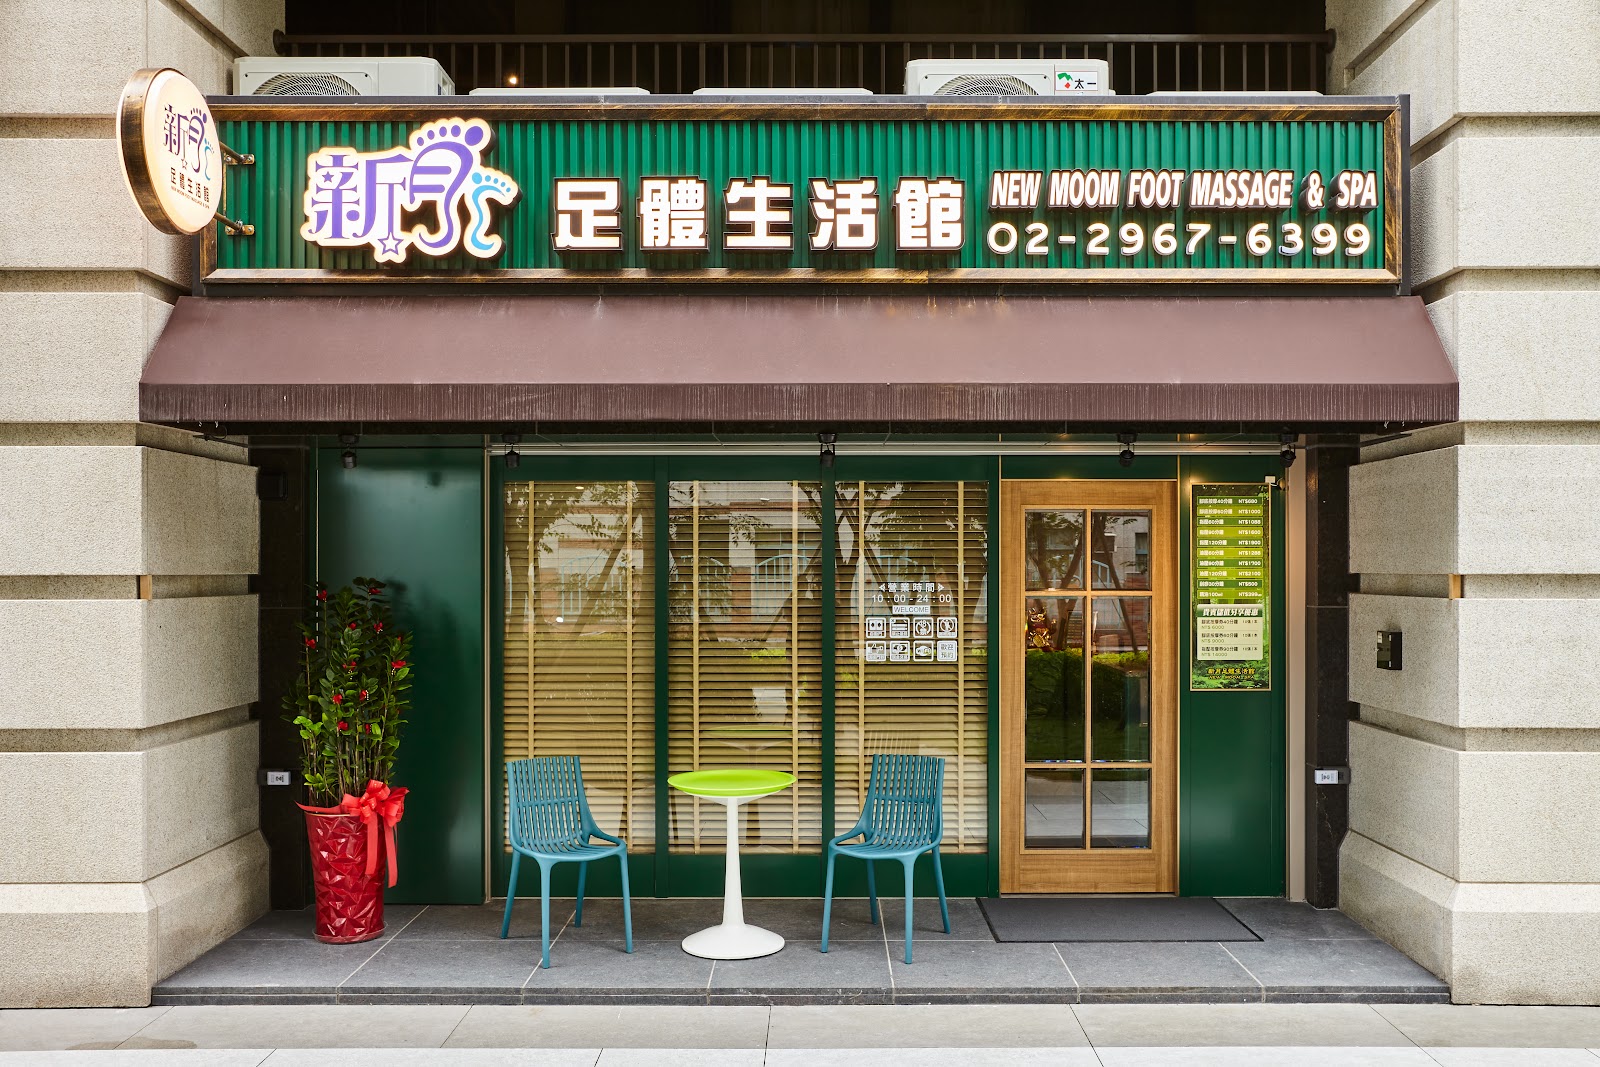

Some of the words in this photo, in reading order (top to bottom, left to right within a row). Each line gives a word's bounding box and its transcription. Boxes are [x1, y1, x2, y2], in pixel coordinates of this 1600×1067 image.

[1074, 78, 1096, 90] 太一
[990, 171, 1042, 208] NEW
[1048, 171, 1120, 208] MOOM
[1127, 171, 1185, 208] FOOT
[1189, 171, 1294, 208] MASSAGE
[1305, 171, 1325, 208] &
[1335, 171, 1378, 208] SPA
[553, 178, 965, 249] 足體生活館
[986, 222, 1371, 257] 02-2967-6399
[888, 583, 935, 593] 營業時間
